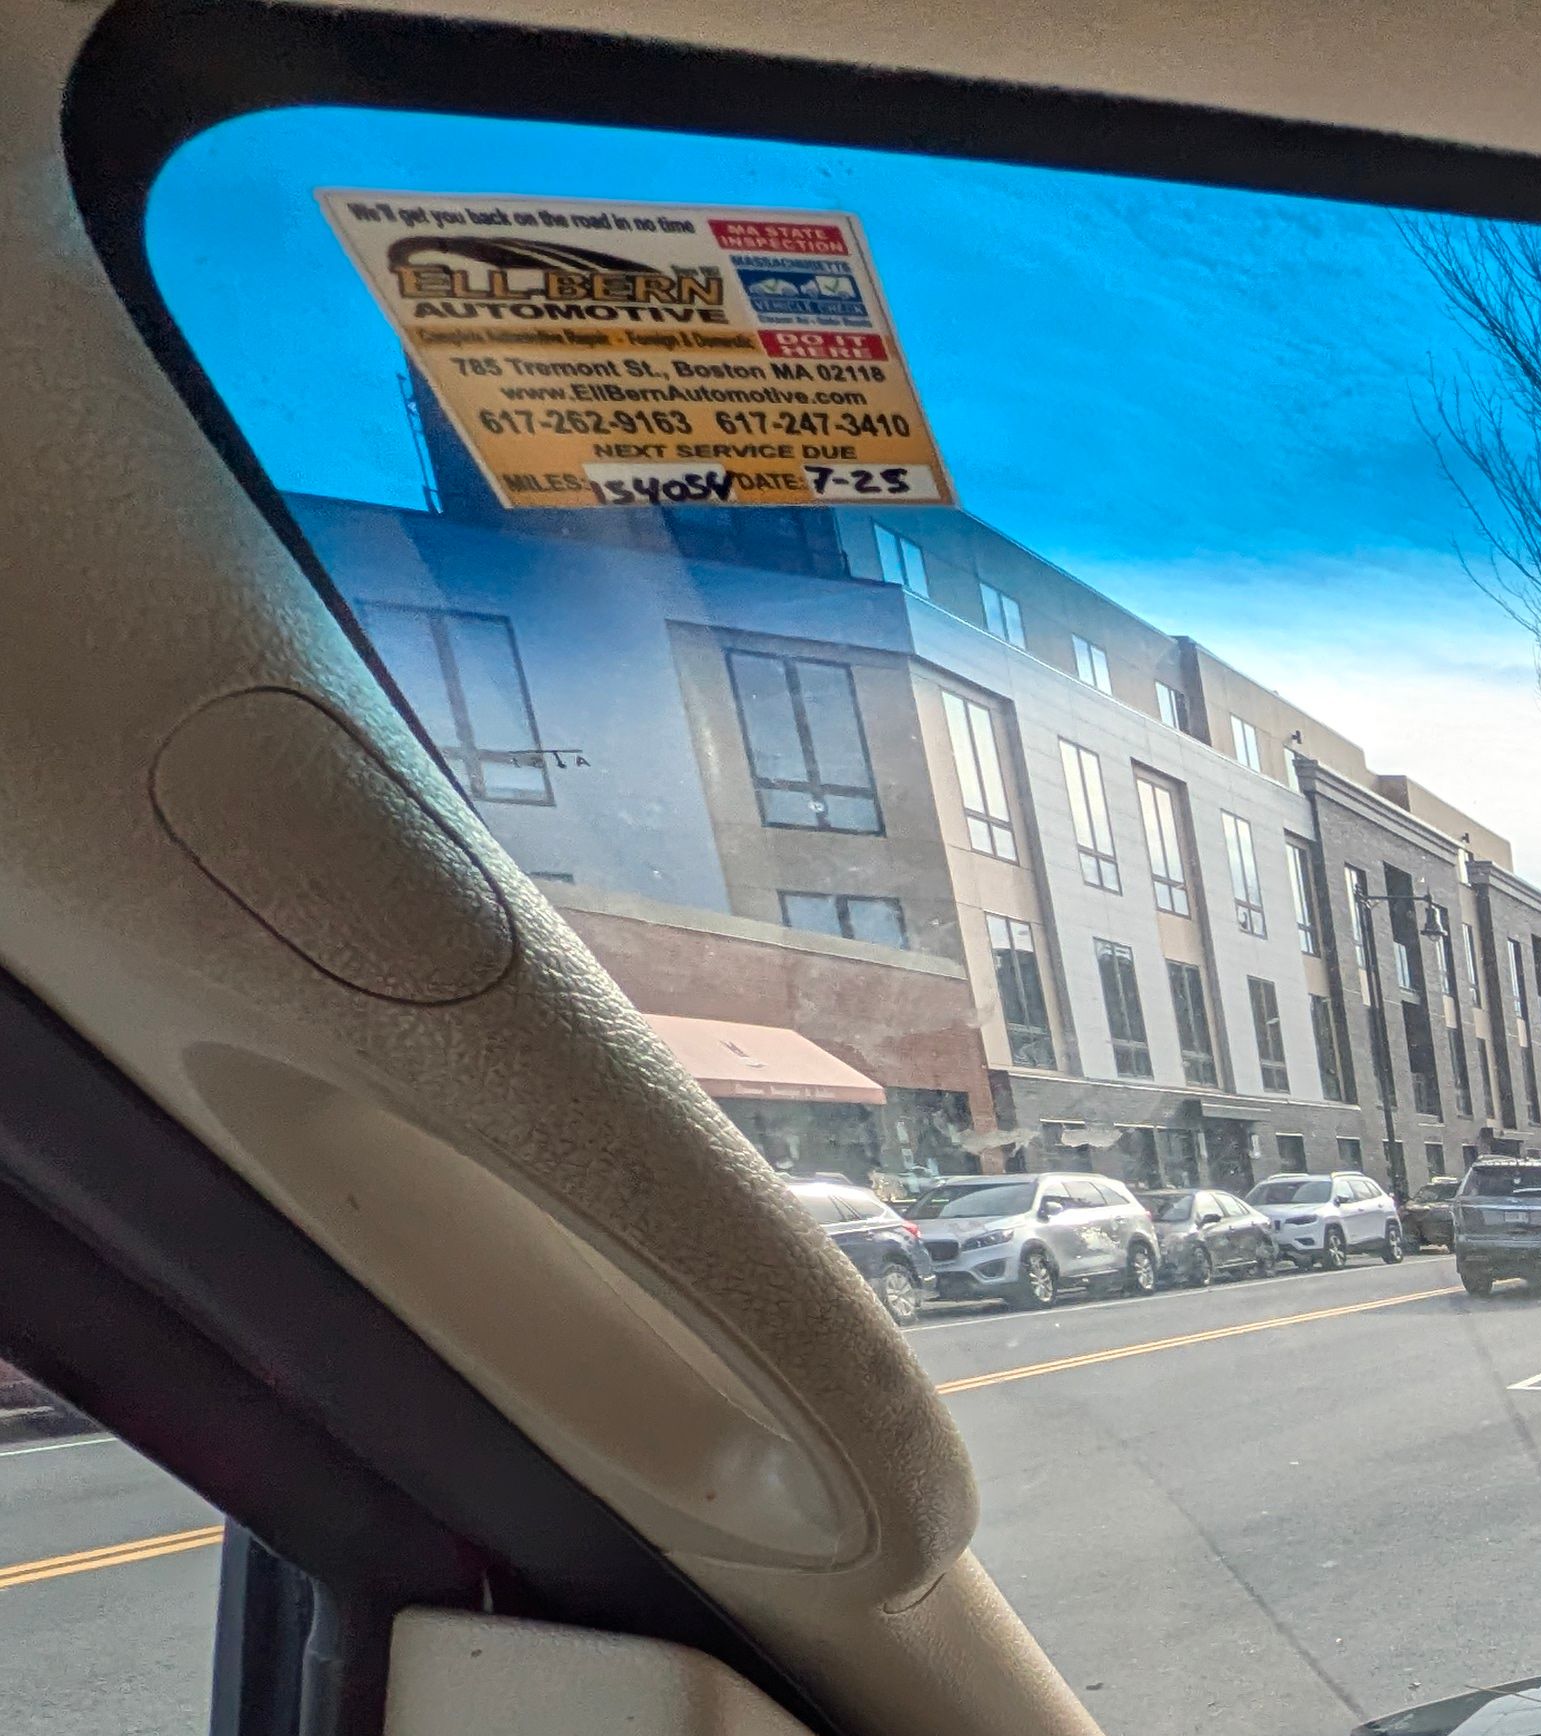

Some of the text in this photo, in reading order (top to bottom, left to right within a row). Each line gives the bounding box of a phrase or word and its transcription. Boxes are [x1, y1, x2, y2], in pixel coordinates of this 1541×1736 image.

[347, 203, 696, 233] We'll get you back on the road in no time
[726, 224, 829, 240] MA STATE
[721, 235, 844, 253] INSPECTION
[414, 301, 729, 325] AUTOMOTIVE
[776, 332, 867, 347] DO IT
[780, 346, 874, 359] HERE
[453, 357, 886, 383] 785 Tremont St., Boston MA 02118
[500, 384, 867, 405] www.EllBernAutomotive.com
[480, 409, 910, 437] 617-262-9163 617-247-3410
[593, 443, 857, 460] NEXT SERVICE DUE
[803, 466, 909, 496] 7-25
